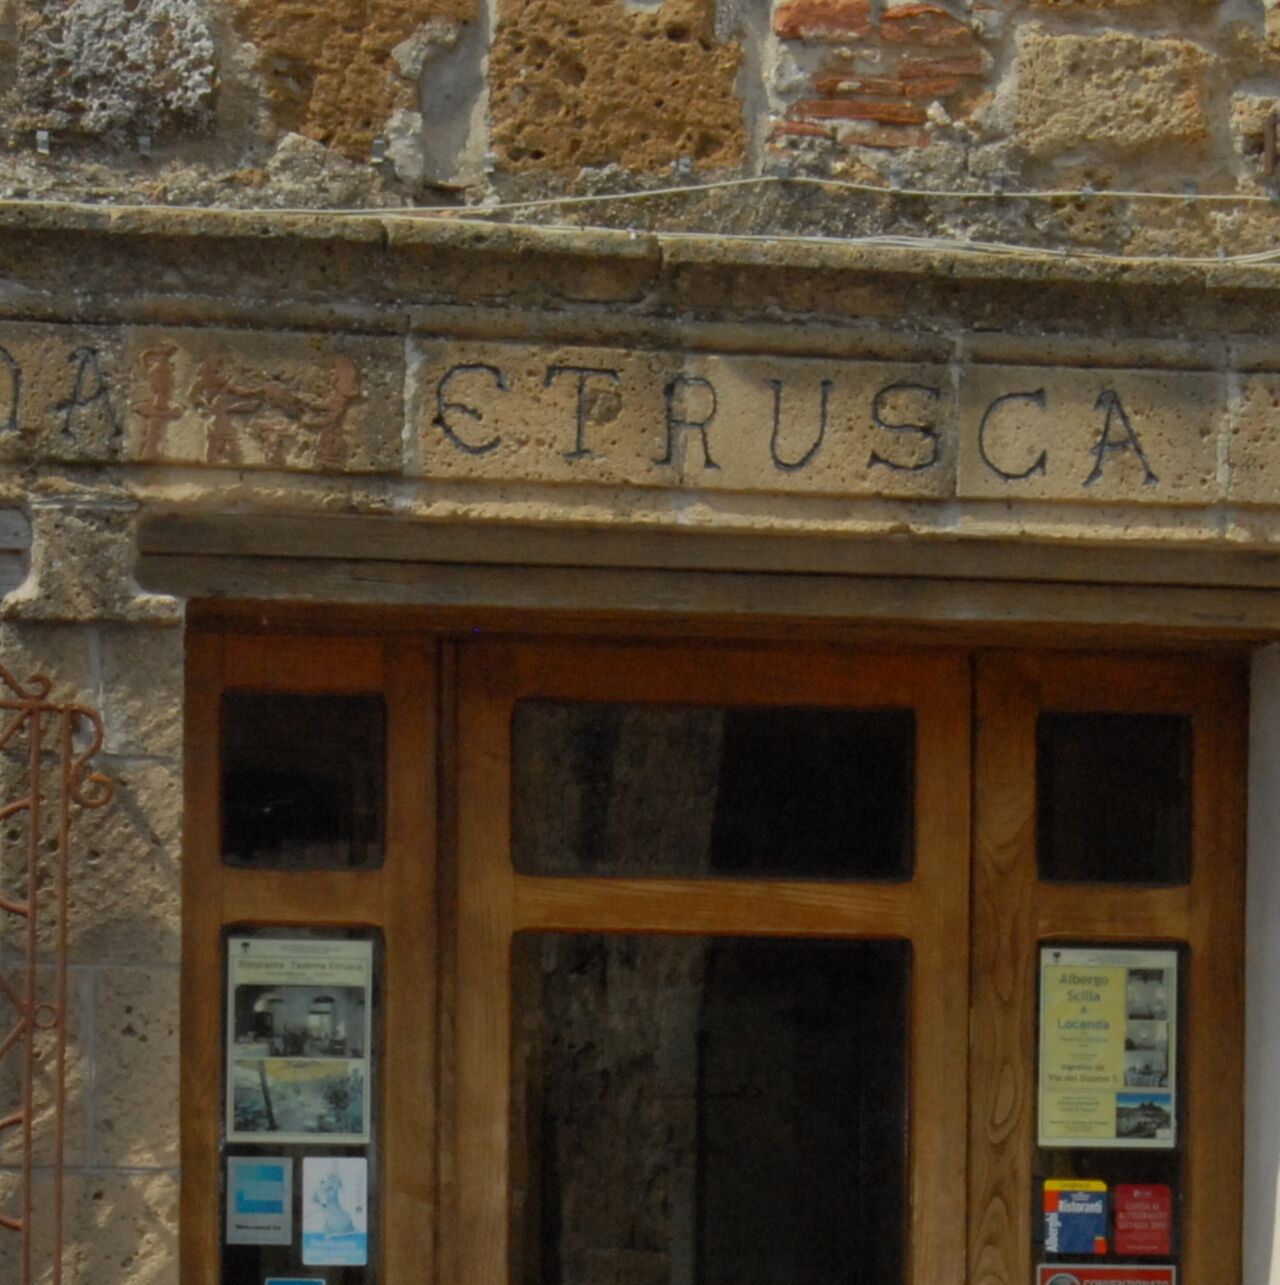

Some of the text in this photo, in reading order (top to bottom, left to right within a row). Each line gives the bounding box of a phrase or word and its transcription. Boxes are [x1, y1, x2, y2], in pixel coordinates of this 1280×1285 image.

[430, 361, 1162, 487] ETRUSCA
[1058, 973, 1109, 987] Albergo
[1058, 1199, 1103, 1213] Ristoranti
